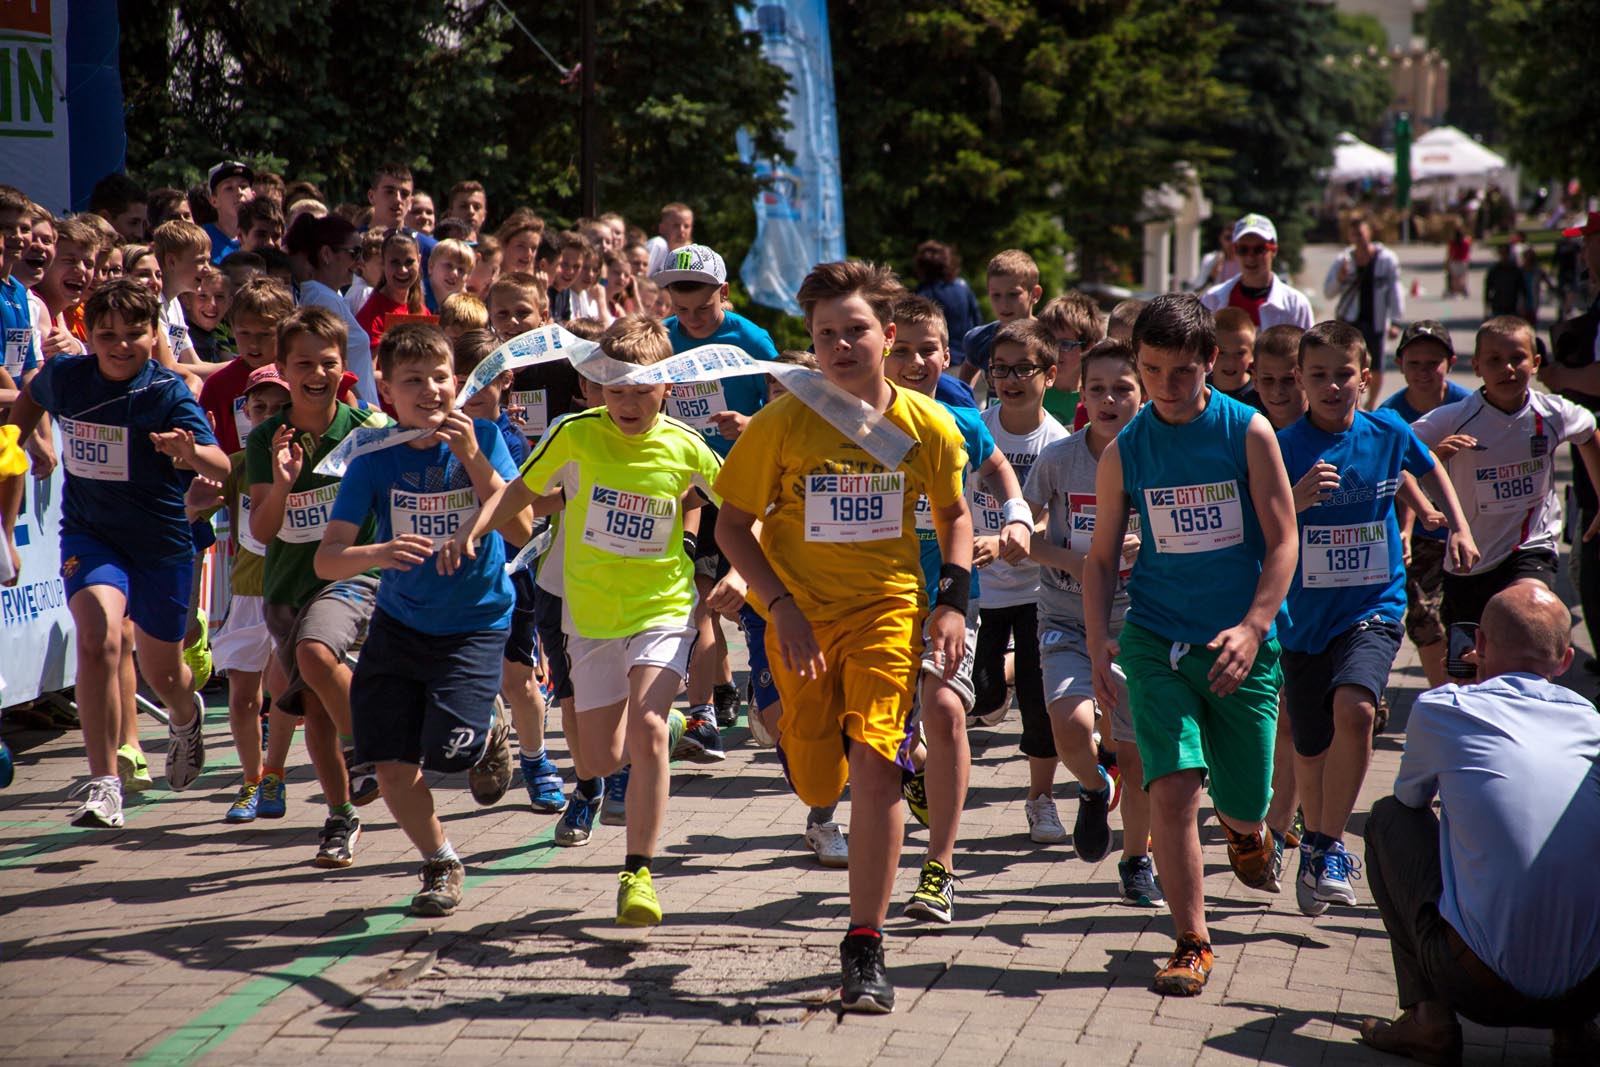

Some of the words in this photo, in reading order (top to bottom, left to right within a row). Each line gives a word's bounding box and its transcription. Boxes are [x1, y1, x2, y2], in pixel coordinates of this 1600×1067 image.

[676, 399, 710, 417] 1852
[69, 437, 109, 464] 1950
[1492, 476, 1534, 500] 1386
[287, 505, 329, 528] 1961
[830, 495, 884, 522] 1969
[1170, 505, 1223, 533] 1953
[410, 513, 460, 536] 1956
[605, 509, 655, 540] 1958
[1326, 546, 1371, 571] 1387
